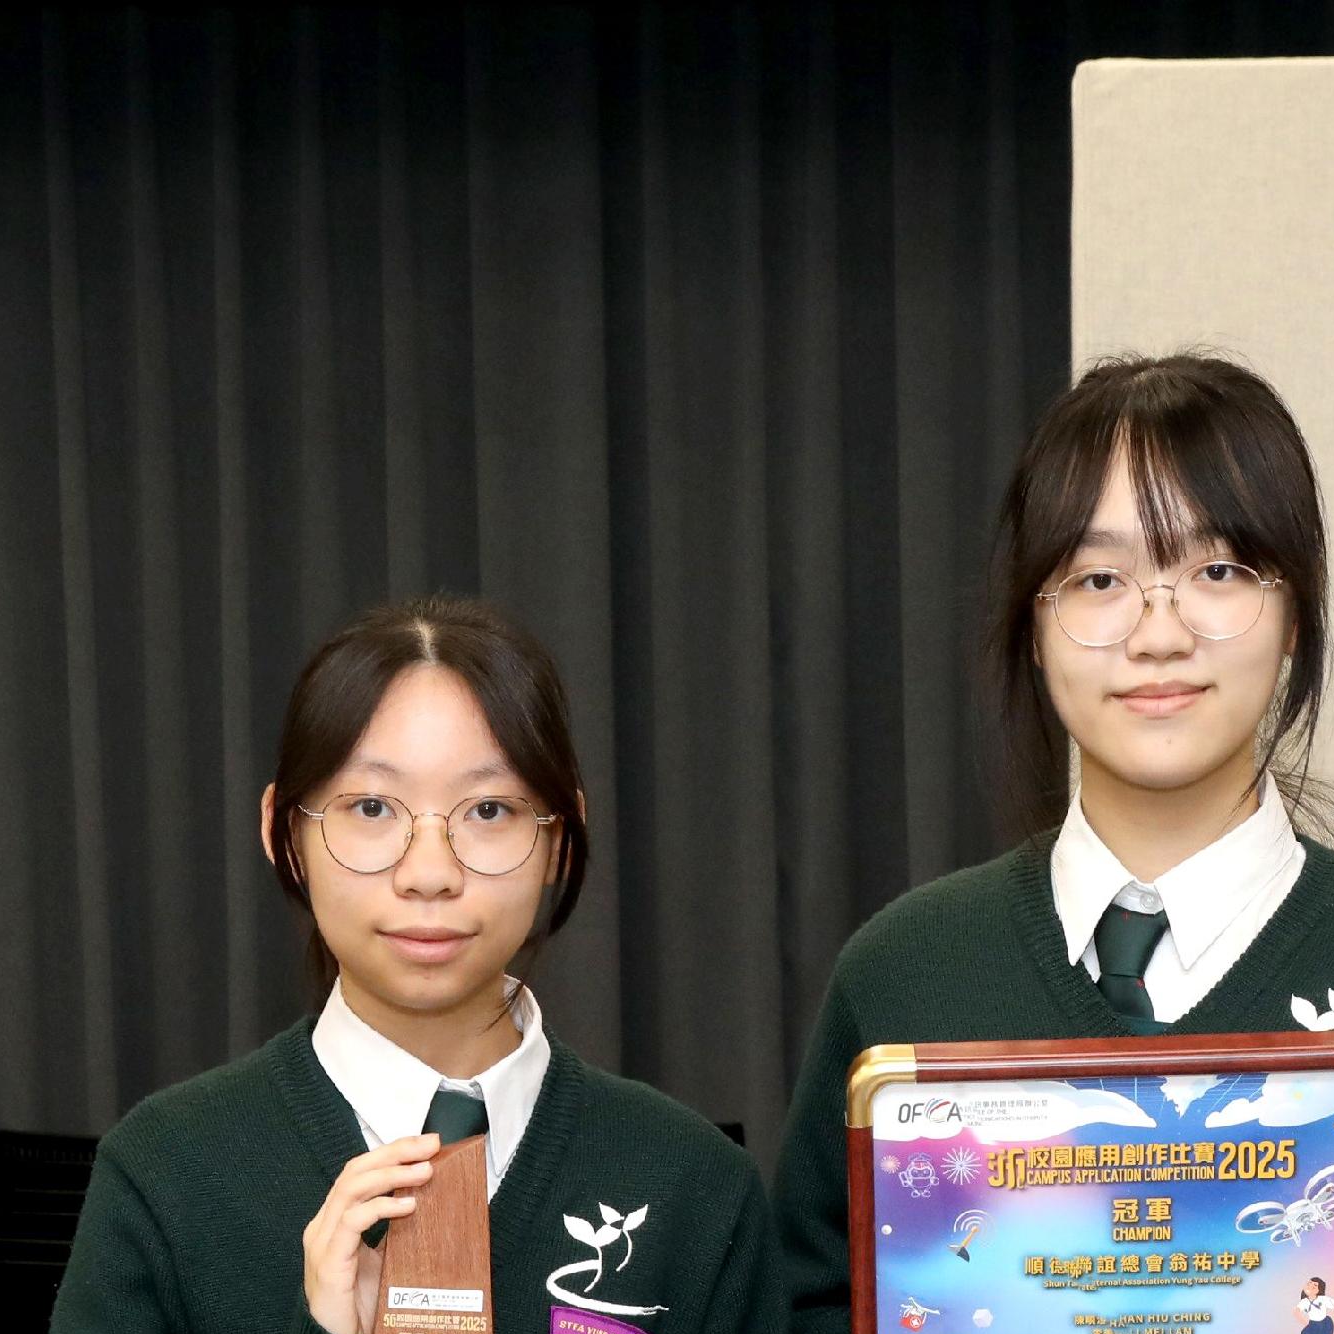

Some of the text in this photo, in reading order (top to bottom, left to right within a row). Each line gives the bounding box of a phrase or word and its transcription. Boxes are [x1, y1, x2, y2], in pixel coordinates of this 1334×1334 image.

[1027, 1141, 1215, 1169] 校園應用創作比賽
[1218, 1139, 1296, 1181] 2025
[1027, 1165, 1215, 1185] CAMPUS APPLICATION COMPETITION
[1112, 1197, 1172, 1223] 冠軍
[1113, 1226, 1171, 1242] CHAMPION
[460, 1316, 487, 1332] 2025
[1172, 1312, 1211, 1323] CHING
